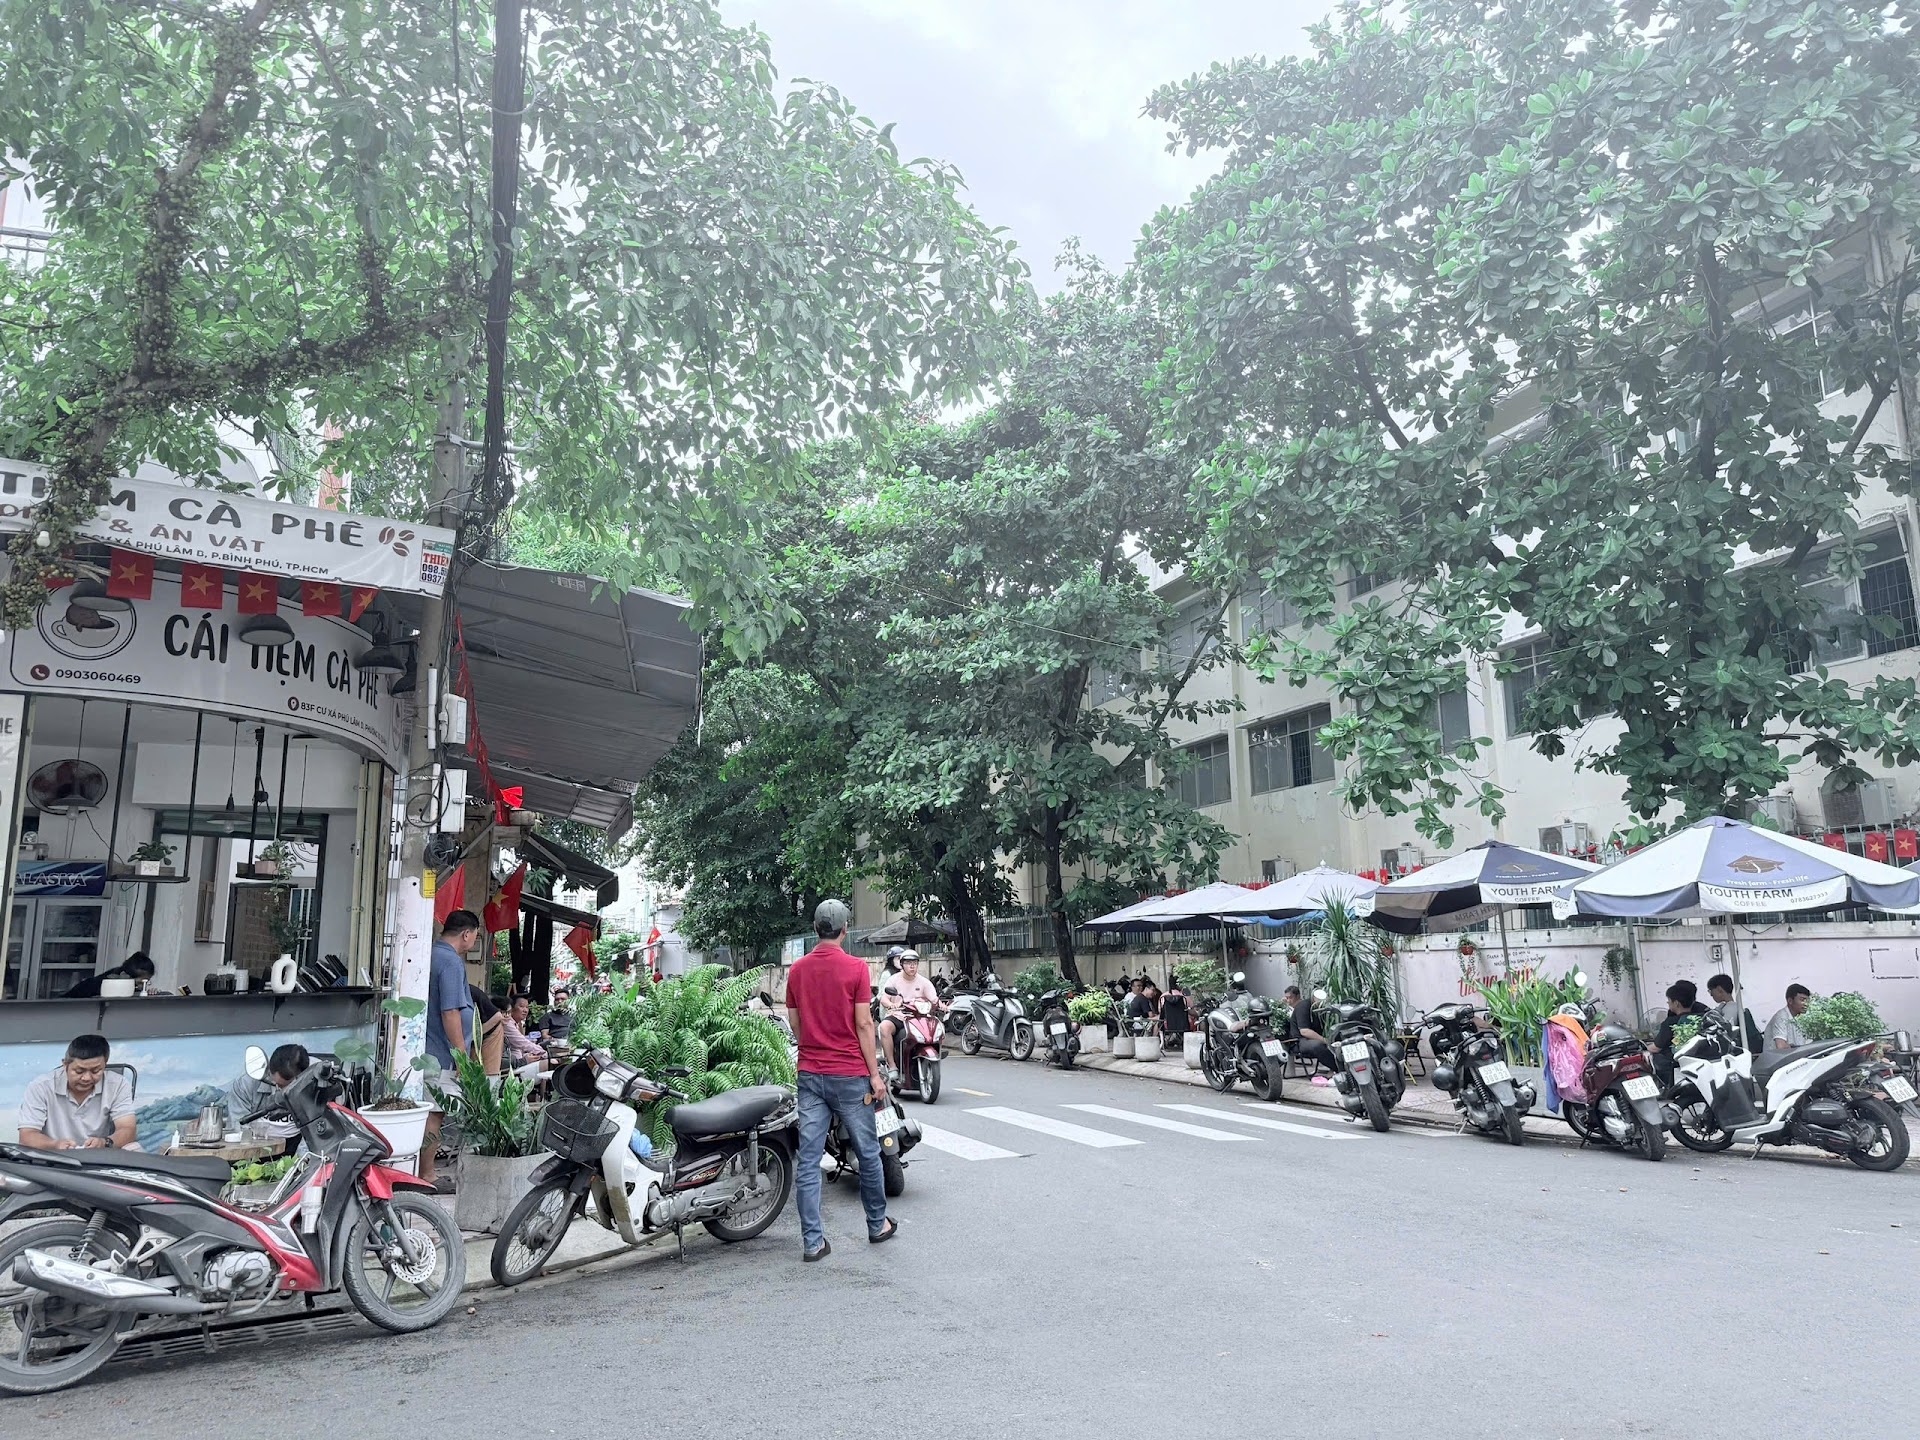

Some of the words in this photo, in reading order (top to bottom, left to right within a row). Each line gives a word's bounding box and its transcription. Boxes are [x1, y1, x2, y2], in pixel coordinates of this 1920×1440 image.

[0, 471, 136, 512] TIM
[168, 498, 242, 529] CÀ
[271, 513, 364, 548] PHÊ
[150, 524, 192, 543] ĂN
[208, 533, 266, 553] VẶT
[136, 540, 162, 551] PHÚ
[166, 543, 193, 556] LÂM
[211, 551, 252, 564] P.BÌNH
[286, 562, 329, 575] TP.HCM
[164, 612, 229, 664] CÁI
[327, 650, 351, 695] CÀ
[55, 669, 142, 684] 0903060469
[300, 702, 315, 712] 83F
[327, 708, 337, 718] XÁ
[337, 713, 350, 723] PHÚ
[1491, 887, 1529, 896] YOUTH
[1531, 885, 1561, 895] FARM
[1706, 885, 1750, 899] YOUTH
[1754, 888, 1794, 899] FARM
[1726, 879, 1748, 887] Fresh
[1747, 880, 1768, 888] farm
[1772, 877, 1795, 886] Fresh
